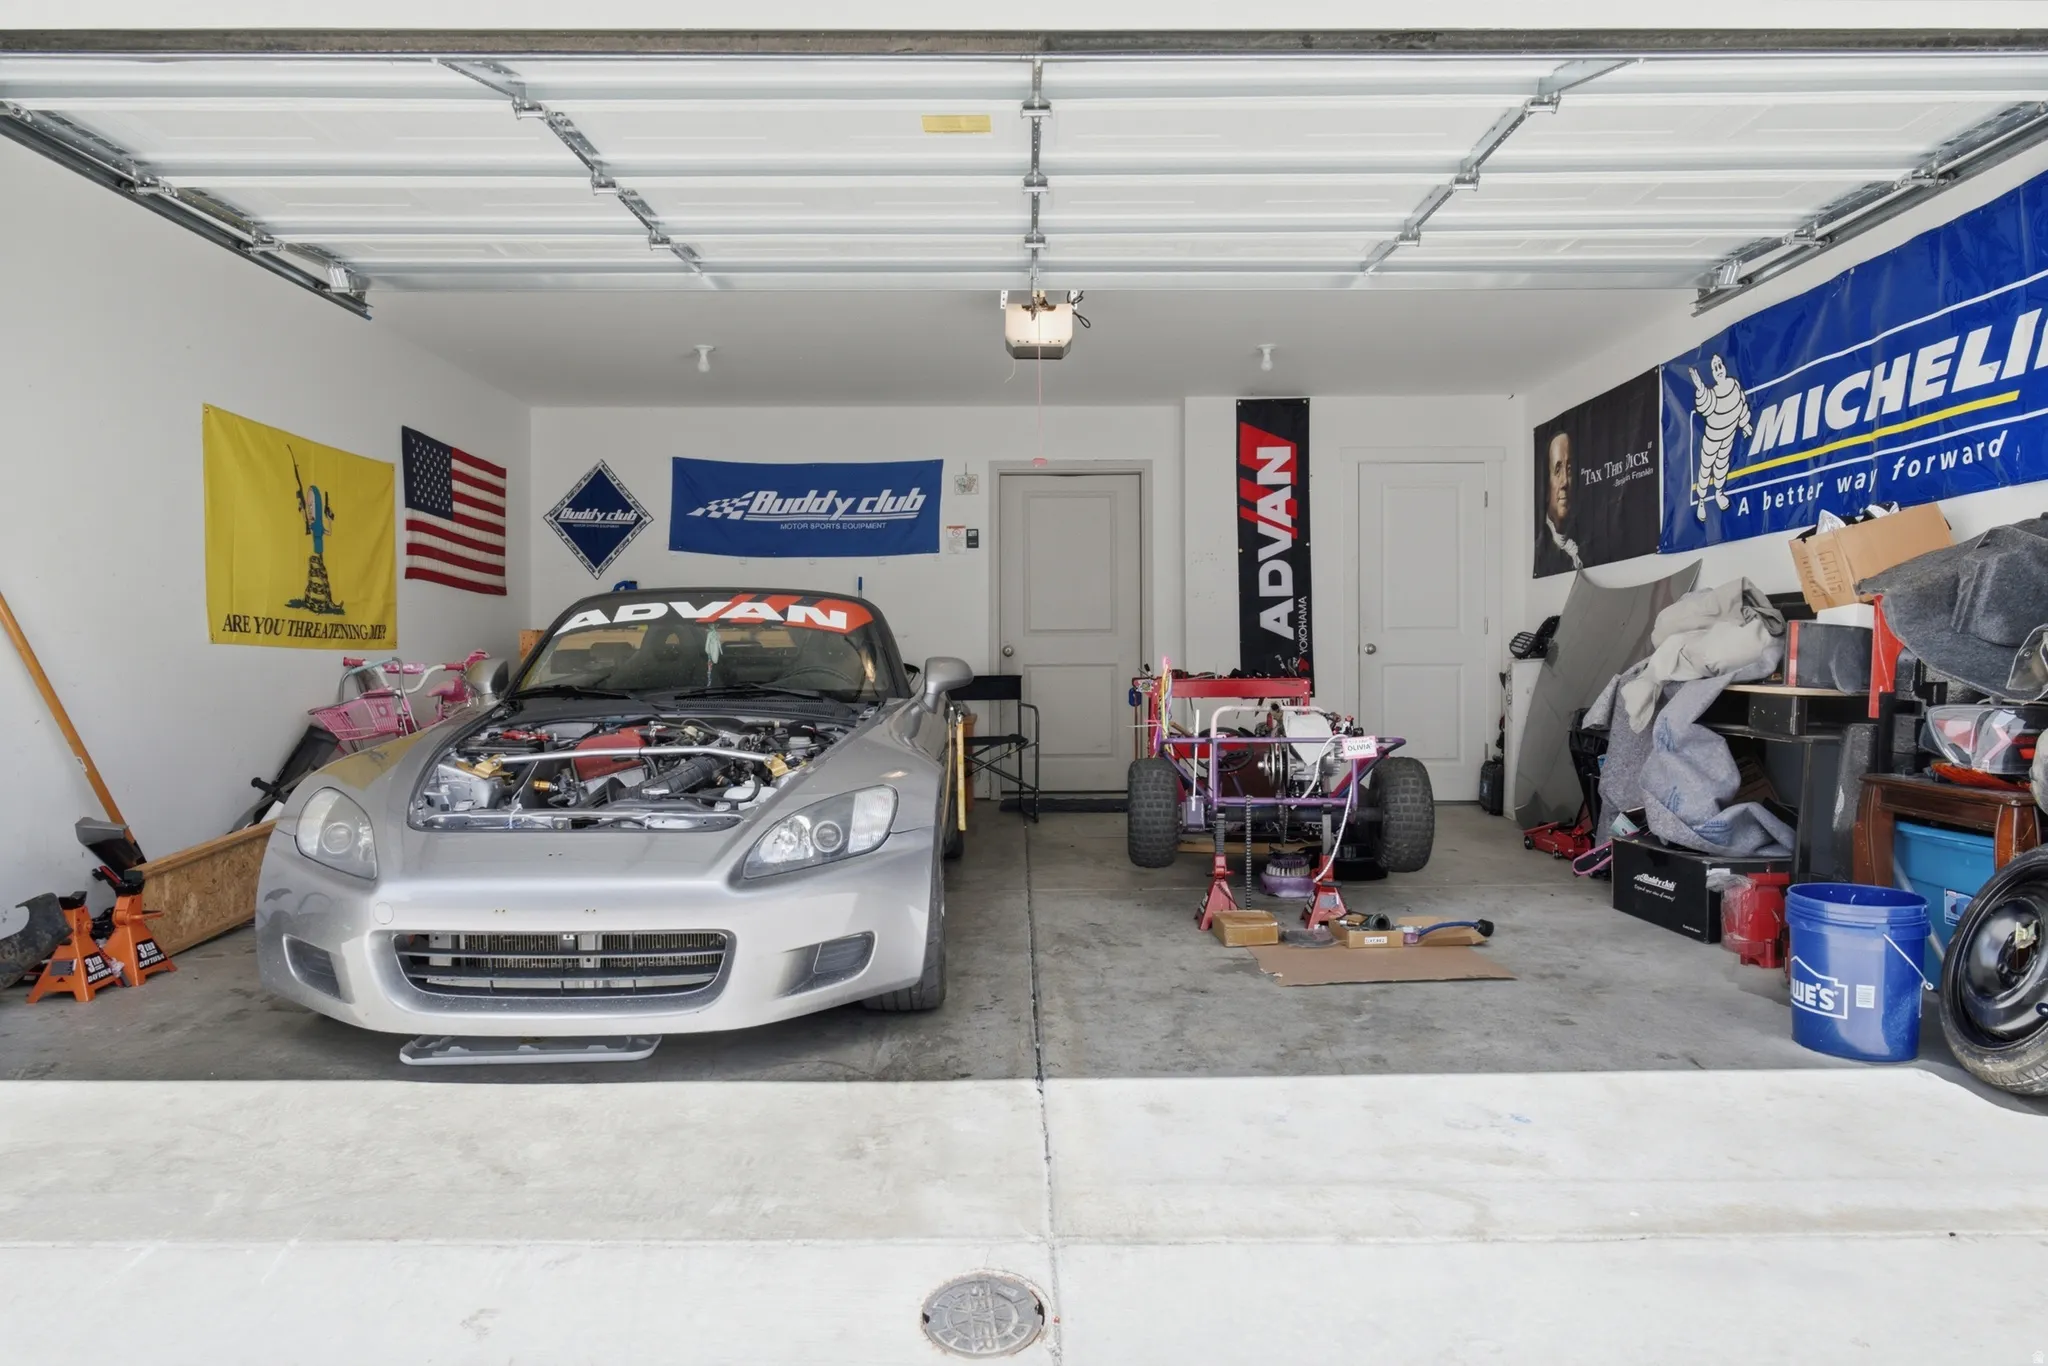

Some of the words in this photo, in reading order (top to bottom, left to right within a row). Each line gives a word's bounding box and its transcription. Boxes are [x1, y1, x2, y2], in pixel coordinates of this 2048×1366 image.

[1737, 497, 1750, 517] A
[1763, 480, 1824, 512] better
[1837, 467, 1879, 493] way
[1891, 430, 2009, 482] forward
[559, 507, 606, 523] Buddy
[606, 508, 638, 521] club
[749, 489, 856, 521] Buddy
[856, 487, 927, 514] club
[780, 522, 808, 530] MOTOR
[810, 522, 841, 530] SPORTS
[842, 522, 887, 530] EQUIPMENT
[1256, 446, 1295, 640] ADVAN
[222, 613, 251, 633] ARE
[252, 616, 285, 636] YOU
[287, 619, 369, 640] THREATENING
[369, 623, 387, 640] ME?
[553, 601, 847, 636] ADVAN
[1299, 596, 1308, 655] YOKOHAMA
[1347, 744, 1371, 752] OLIVIA
